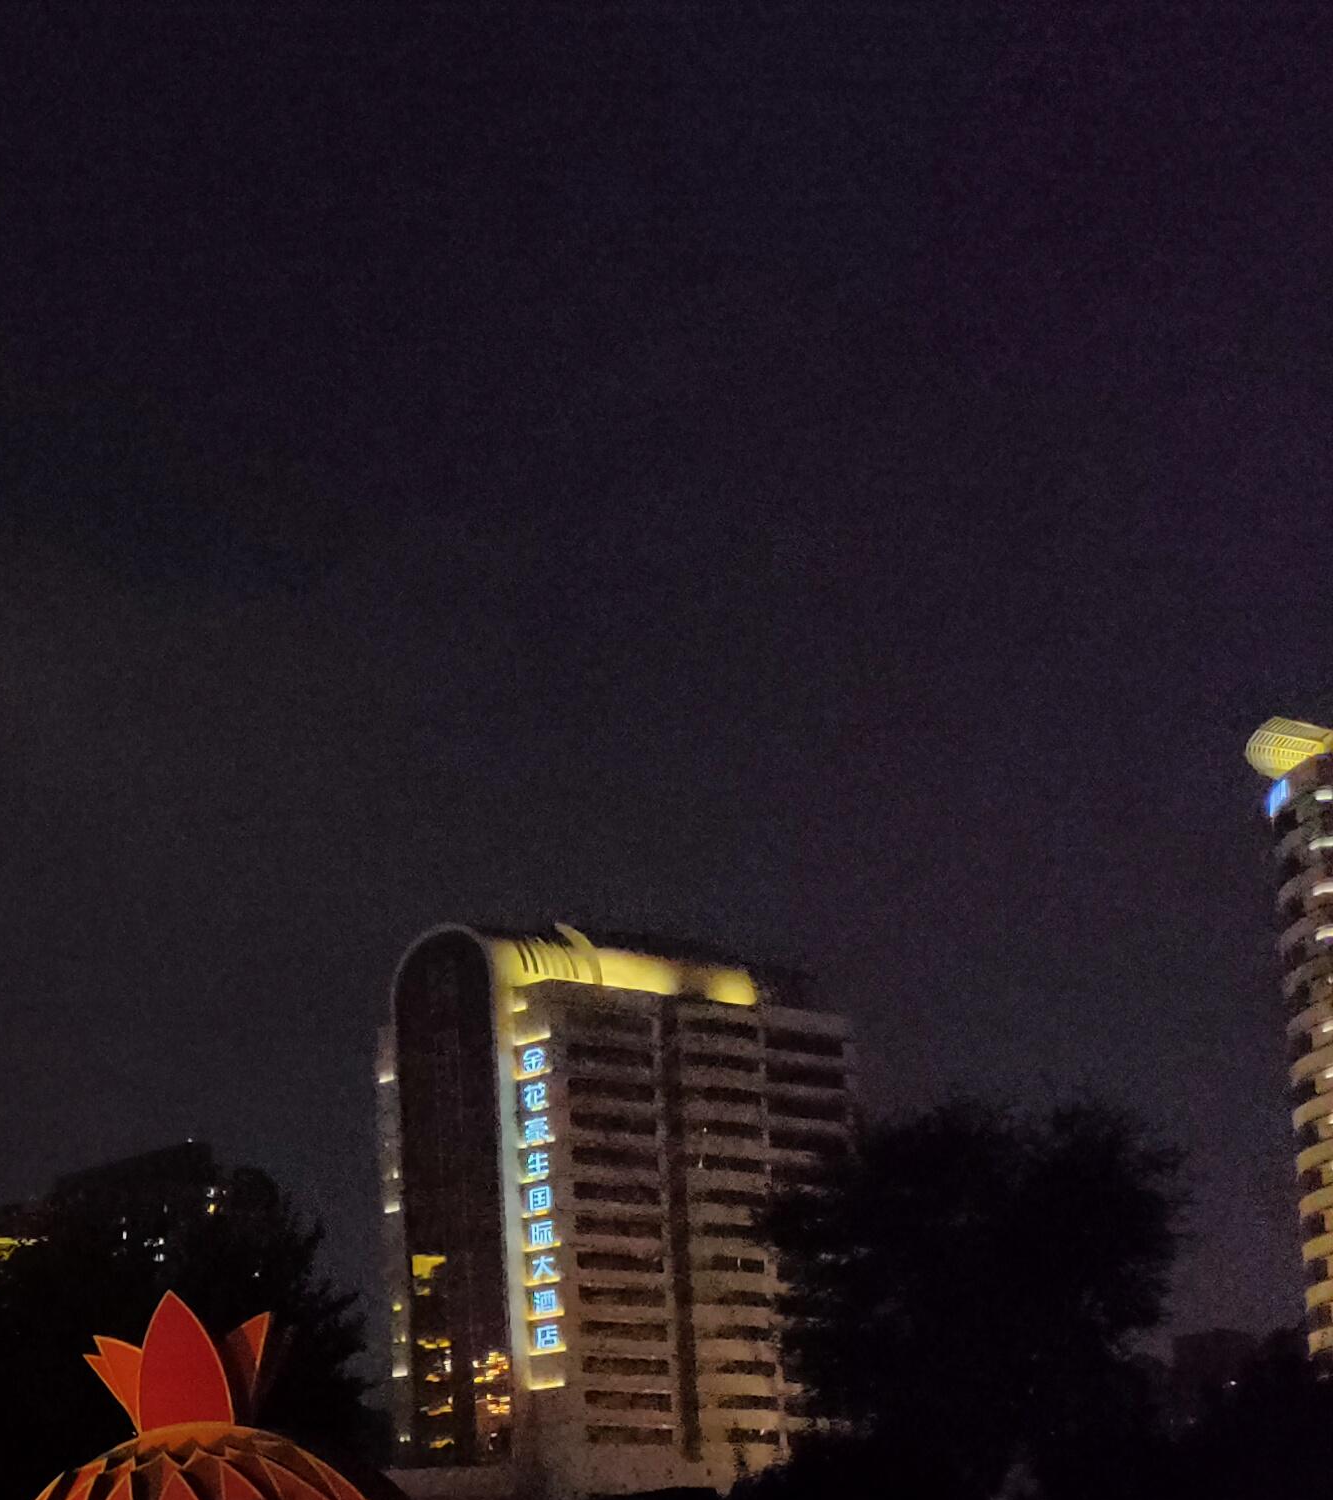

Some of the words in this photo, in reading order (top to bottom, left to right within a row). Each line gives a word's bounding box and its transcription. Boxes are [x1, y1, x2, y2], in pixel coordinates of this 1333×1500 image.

[522, 1048, 558, 1349] 金花豪生国际大酒店
